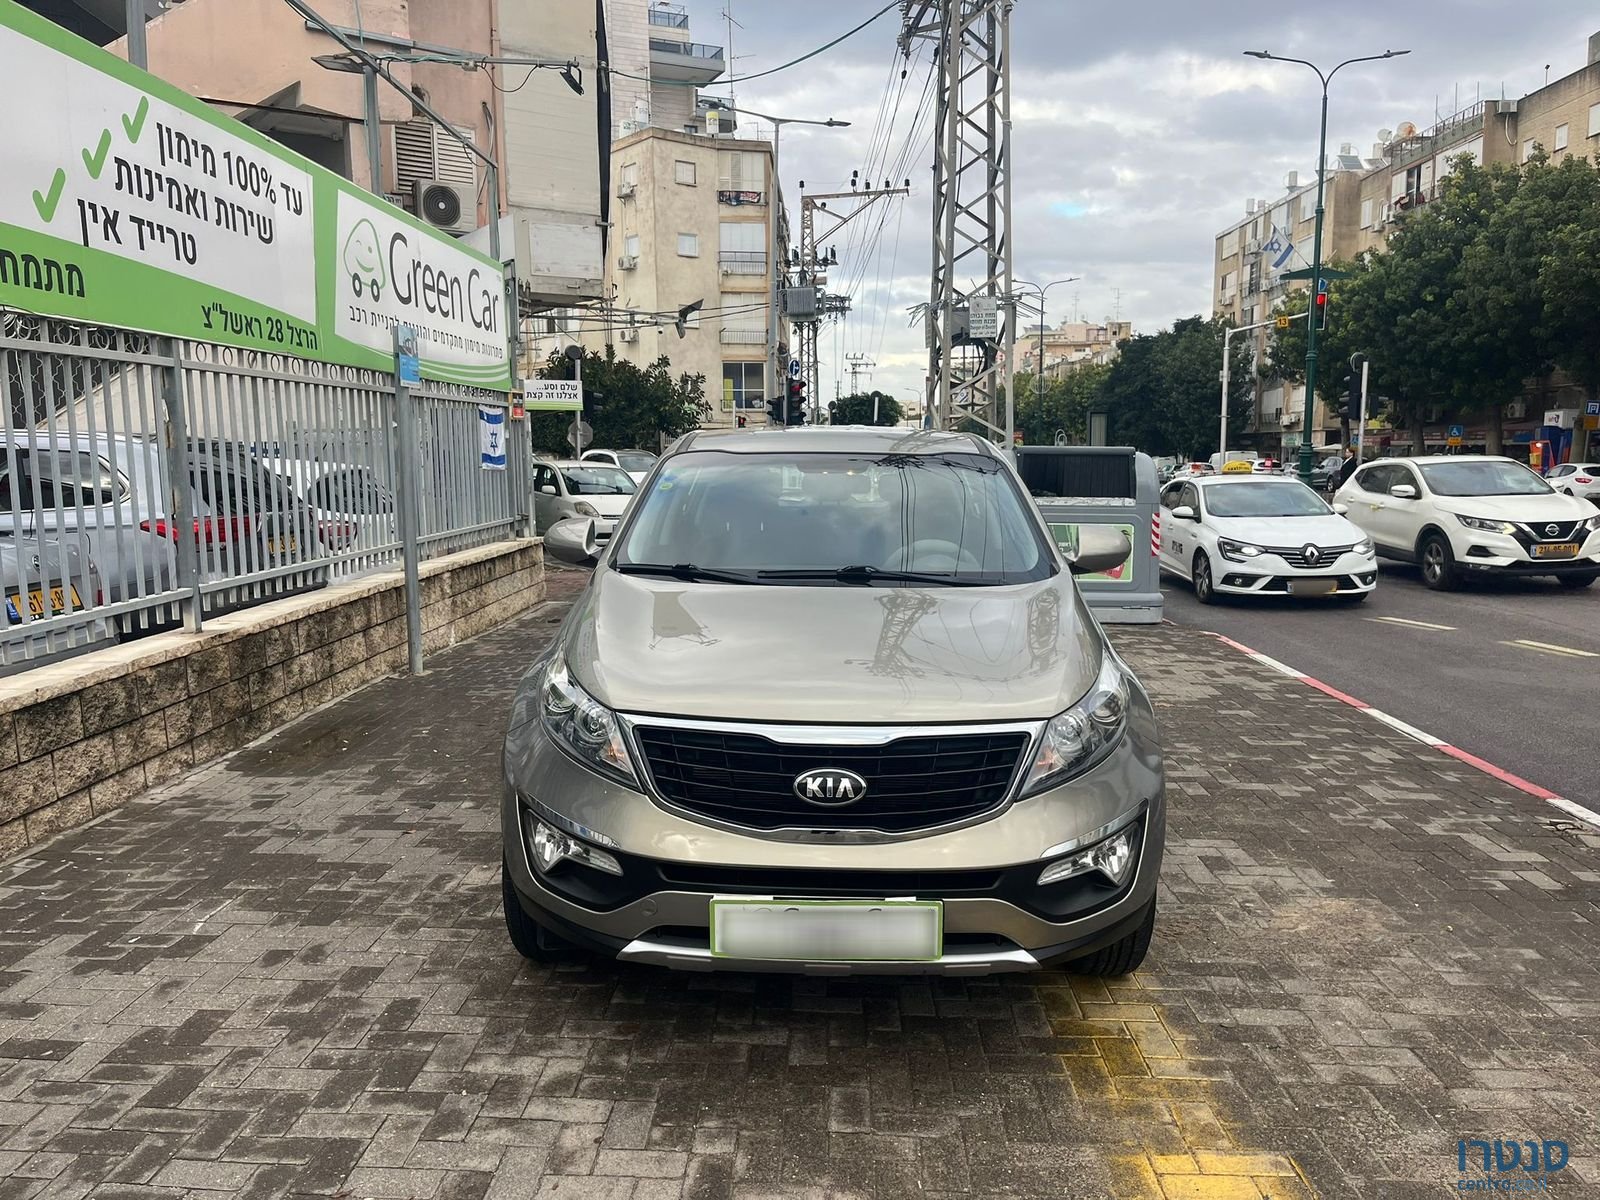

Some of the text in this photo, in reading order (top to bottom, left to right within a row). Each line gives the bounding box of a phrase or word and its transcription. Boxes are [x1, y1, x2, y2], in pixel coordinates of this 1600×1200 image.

[156, 122, 303, 216] עד 100% מימון
[113, 155, 274, 245] שירות ואמינות
[77, 198, 197, 265] טרייד אין
[389, 231, 499, 333] Green Car
[348, 305, 368, 325] רכב
[1278, 317, 1288, 326] 13
[266, 316, 284, 343] 28
[286, 319, 318, 351] הרצל
[432, 329, 463, 350] מתקדמים
[526, 391, 578, 400] אצלנו זה קצת
[560, 382, 578, 391] שלם
[806, 777, 855, 798] KIA
